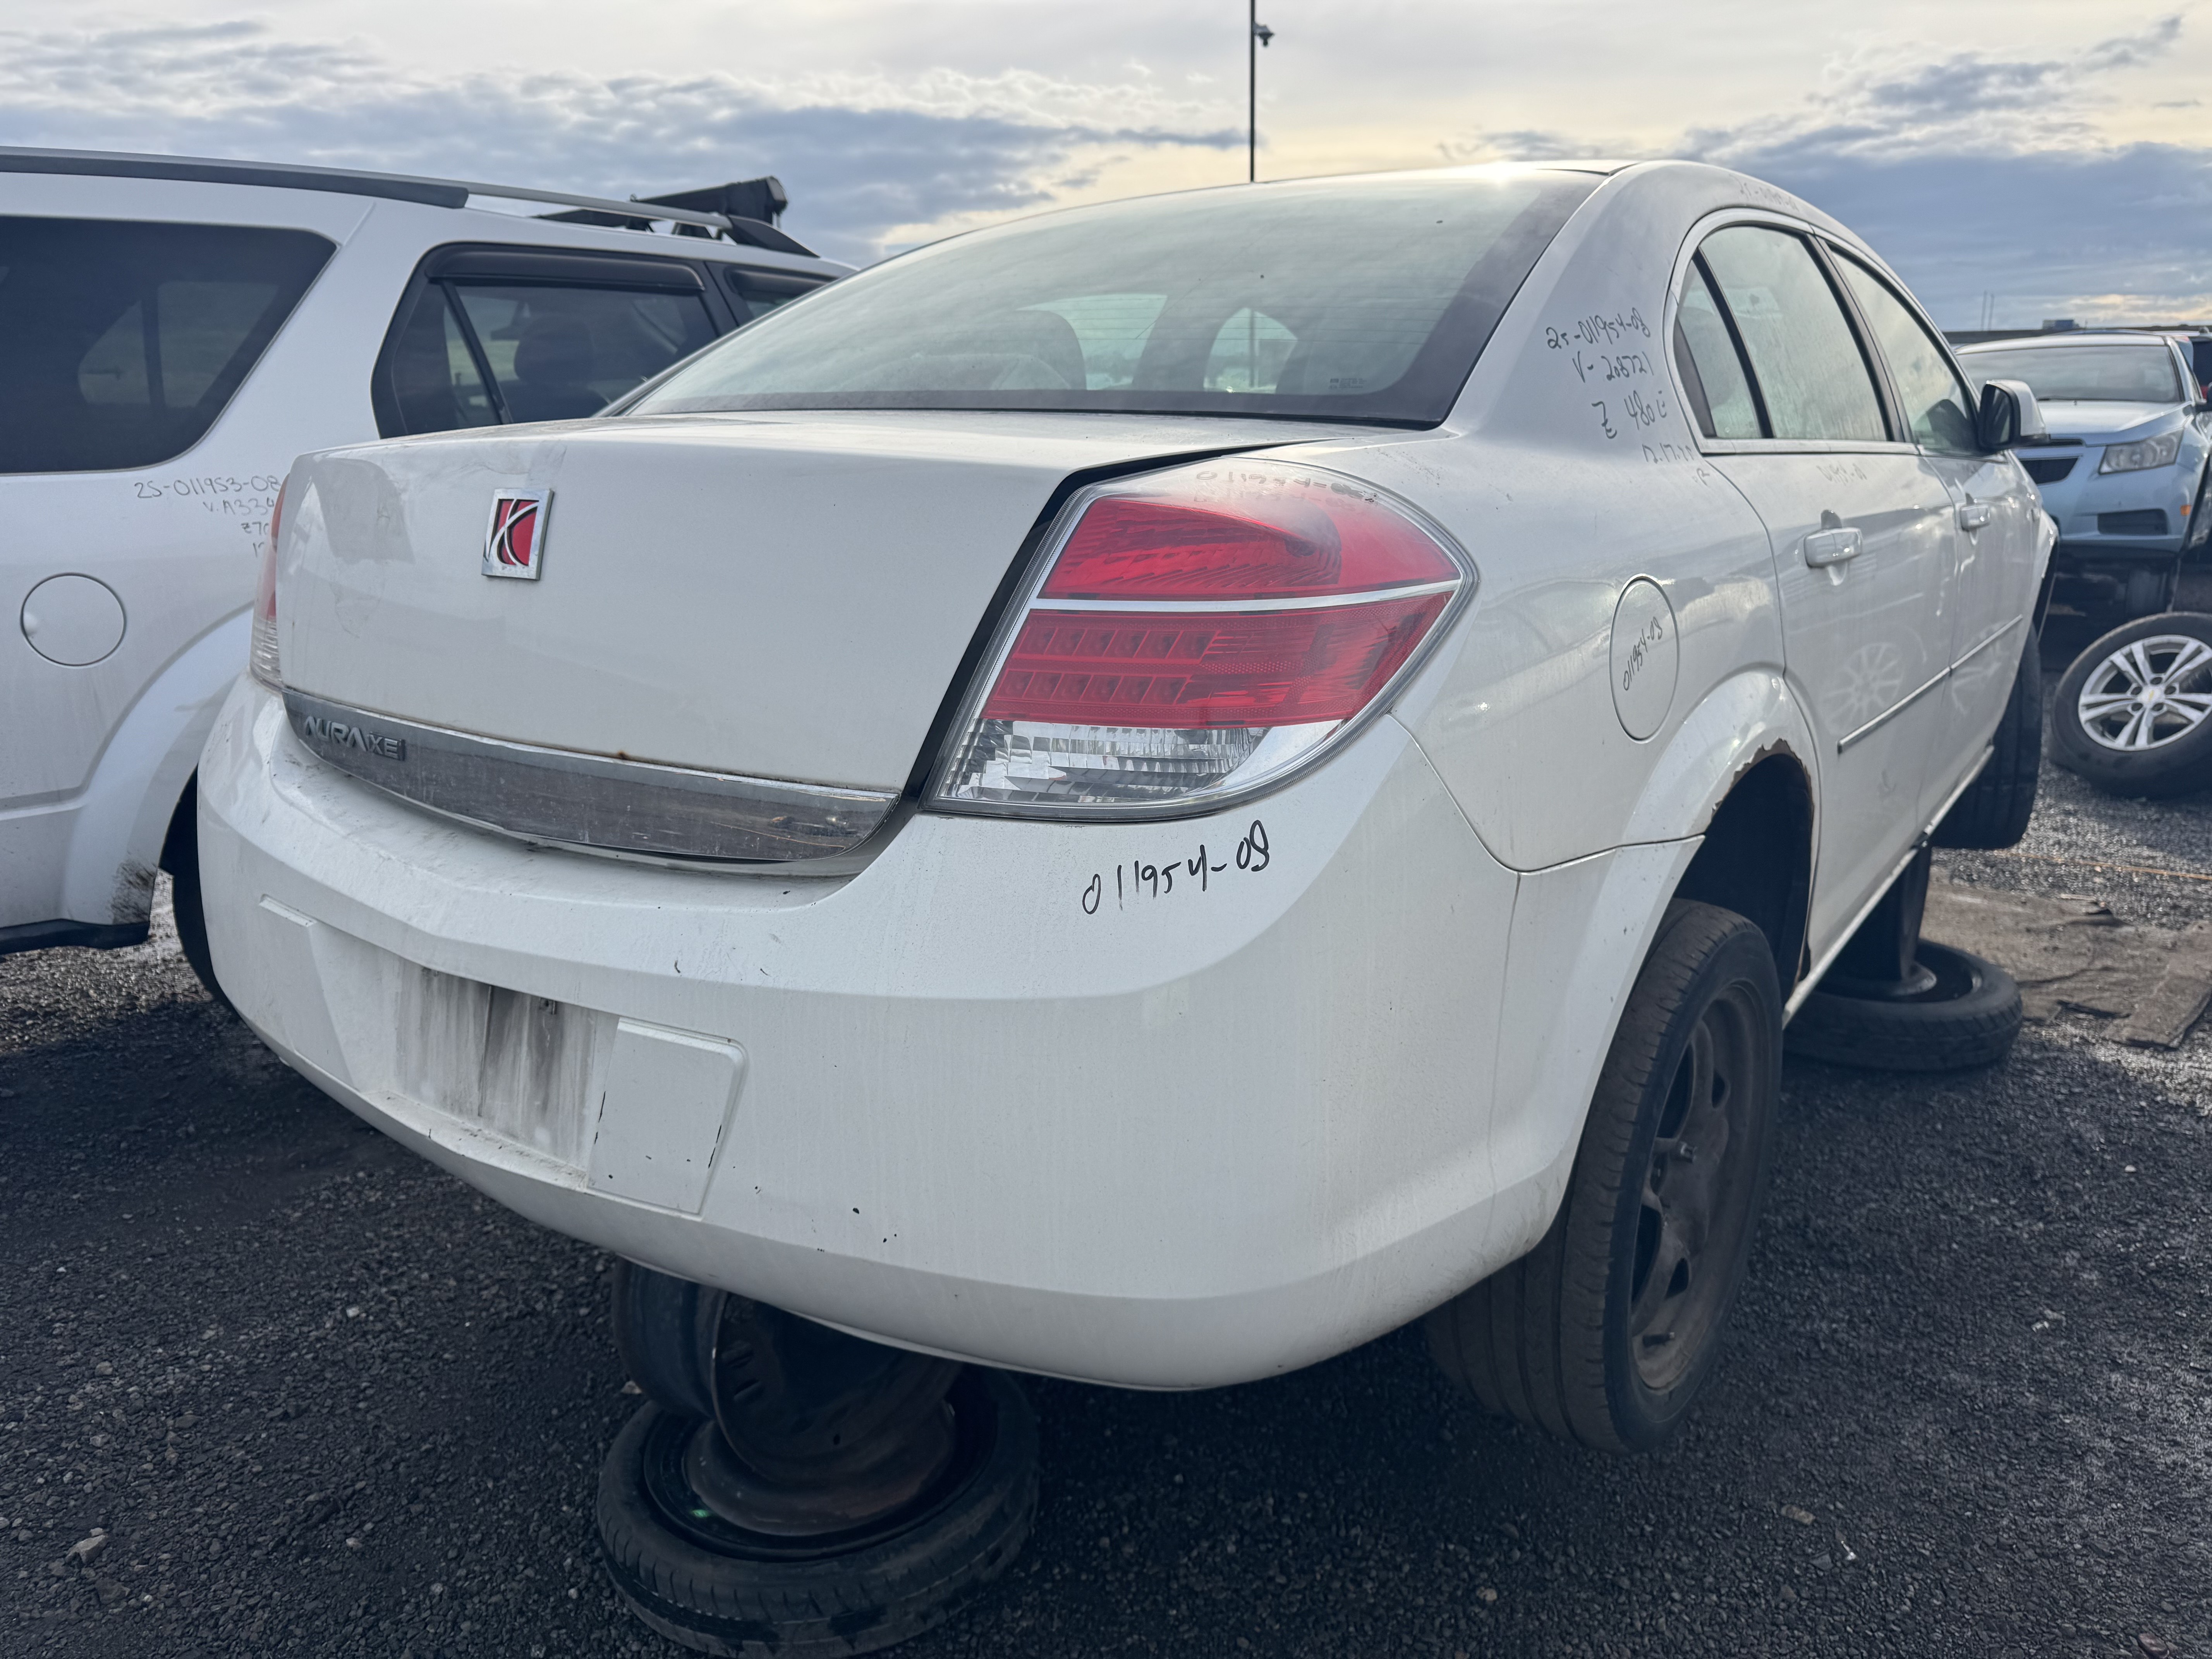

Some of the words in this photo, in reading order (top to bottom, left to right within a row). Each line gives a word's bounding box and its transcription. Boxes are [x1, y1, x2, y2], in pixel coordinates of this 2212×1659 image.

[134, 476, 281, 498] 25-011953-08
[304, 716, 367, 752] AURA
[370, 735, 399, 760] XE
